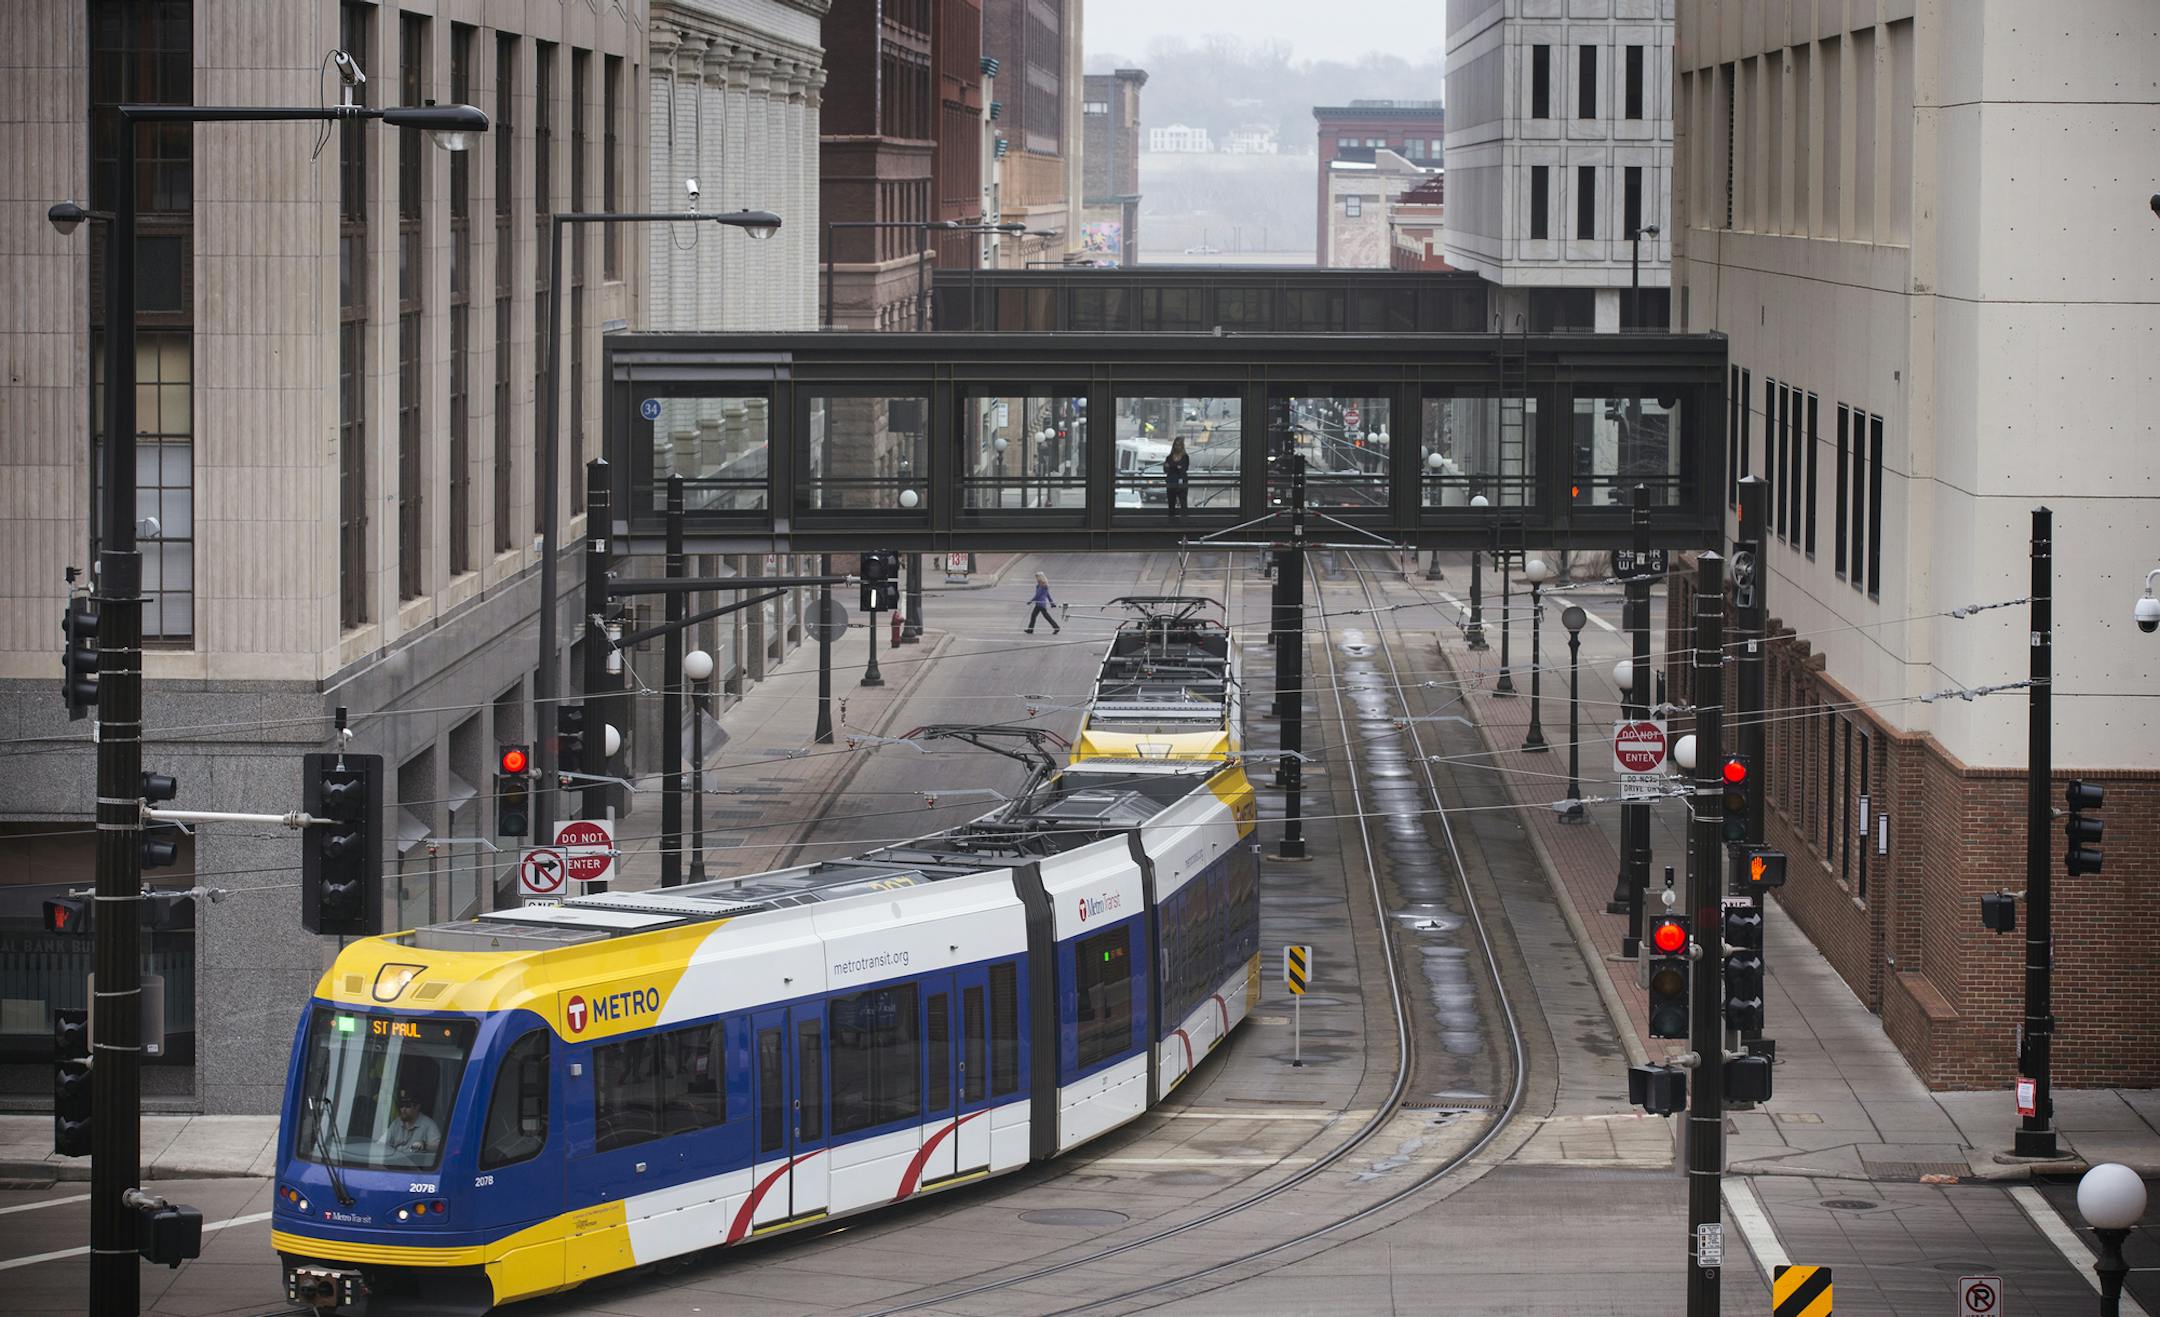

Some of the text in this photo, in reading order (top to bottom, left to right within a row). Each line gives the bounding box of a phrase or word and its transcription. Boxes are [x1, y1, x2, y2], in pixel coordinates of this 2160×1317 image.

[645, 403, 658, 415] 34
[1622, 731, 1659, 739] DO NOT
[1625, 753, 1656, 762] ENTER
[561, 832, 604, 844] DO NOT
[568, 859, 601, 870] ENTER
[23, 939, 66, 952] BANK
[833, 951, 909, 976] metrotransit.org
[592, 987, 660, 1023] METRO
[373, 1020, 421, 1038] ST PAUL
[475, 1175, 494, 1188] 207B
[409, 1183, 436, 1194] 207B
